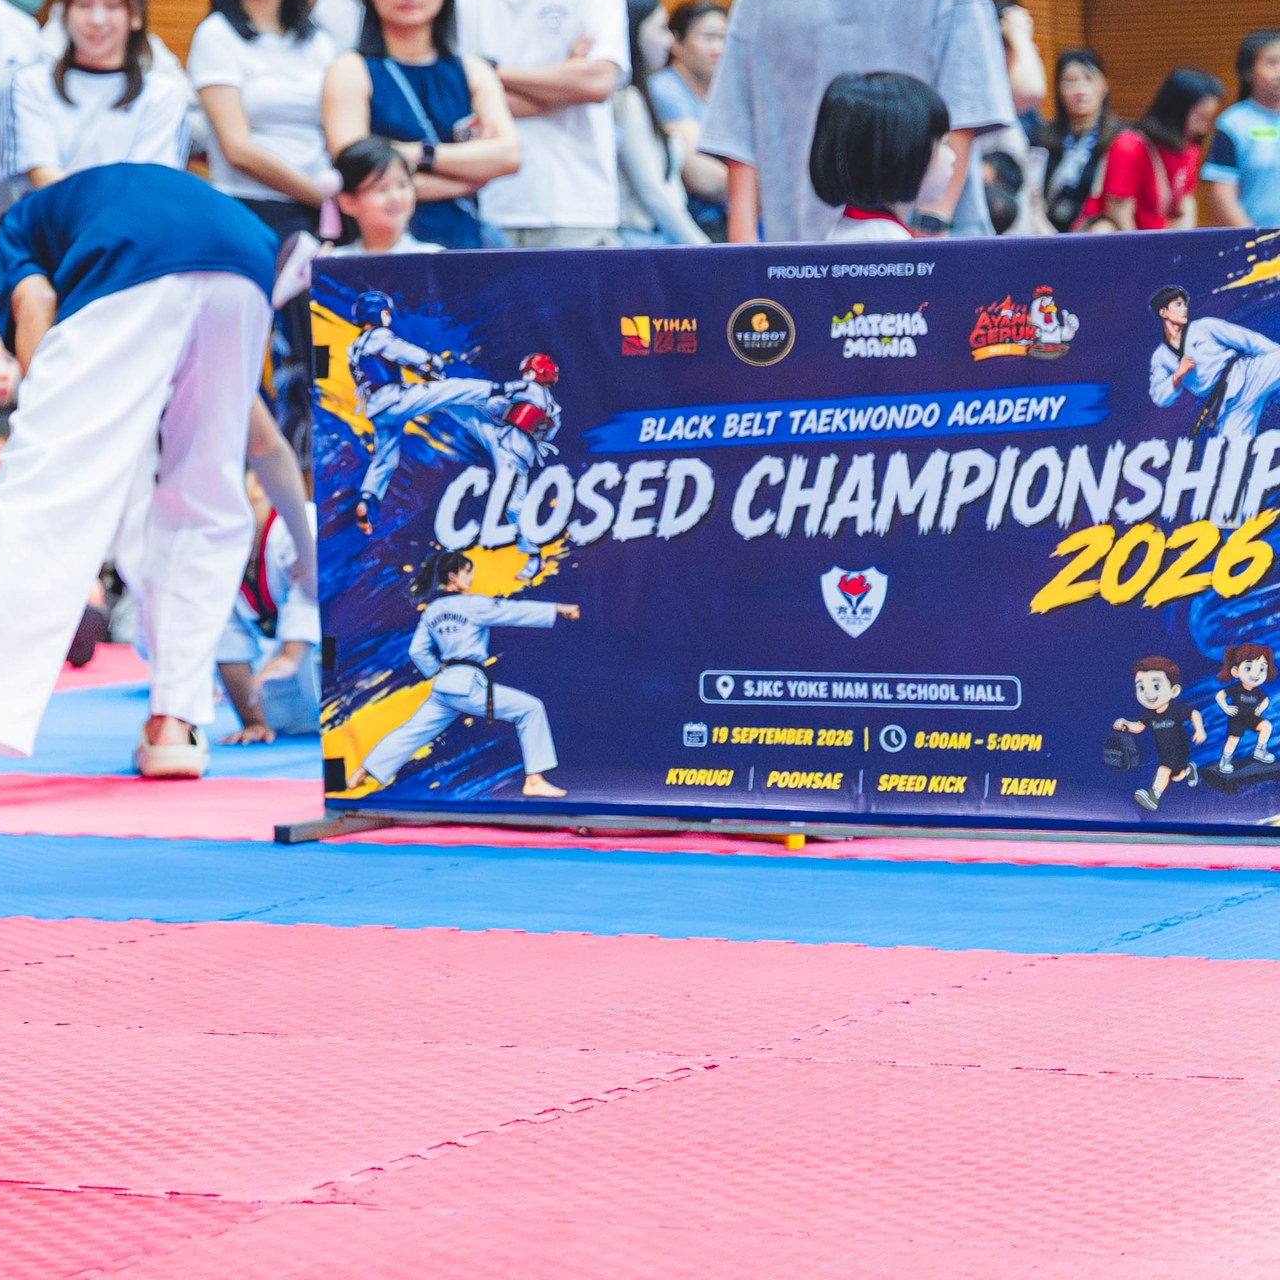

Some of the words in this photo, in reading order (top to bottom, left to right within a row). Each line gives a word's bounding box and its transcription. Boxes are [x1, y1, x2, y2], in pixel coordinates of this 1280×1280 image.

[768, 265, 829, 279] PROUDLY
[831, 263, 915, 278] SPONSORED
[916, 262, 936, 276] BY
[652, 318, 697, 332] YIHAI
[830, 311, 928, 338] MATCHA
[968, 325, 1038, 348] GEPUK
[843, 337, 917, 358] MANA
[639, 415, 716, 442] BLACK
[722, 410, 782, 438] BELT
[788, 403, 939, 435] TAEKWONDO
[947, 395, 1066, 426] ACADEMY
[436, 456, 714, 552] CLOSED
[731, 427, 1280, 541] CHAMPIONSHIP
[1030, 508, 1280, 615] 2026
[743, 680, 784, 698] SJKC
[787, 681, 829, 699] YOKE
[831, 682, 868, 699] NAM
[871, 683, 893, 700] KL
[896, 683, 960, 701] SCHOOL
[963, 684, 1006, 702] HALL
[711, 727, 728, 743] 19
[730, 727, 814, 746] SEPTEMBER
[817, 729, 853, 746] 2026
[914, 731, 971, 750] 8:00AM
[987, 733, 1042, 752] 5:00PM
[665, 768, 735, 786] KYORUGI
[766, 770, 843, 790] POOMSAE
[877, 774, 927, 792] SPEED
[928, 775, 967, 793] KICK
[1000, 777, 1057, 796] TAEKIN
